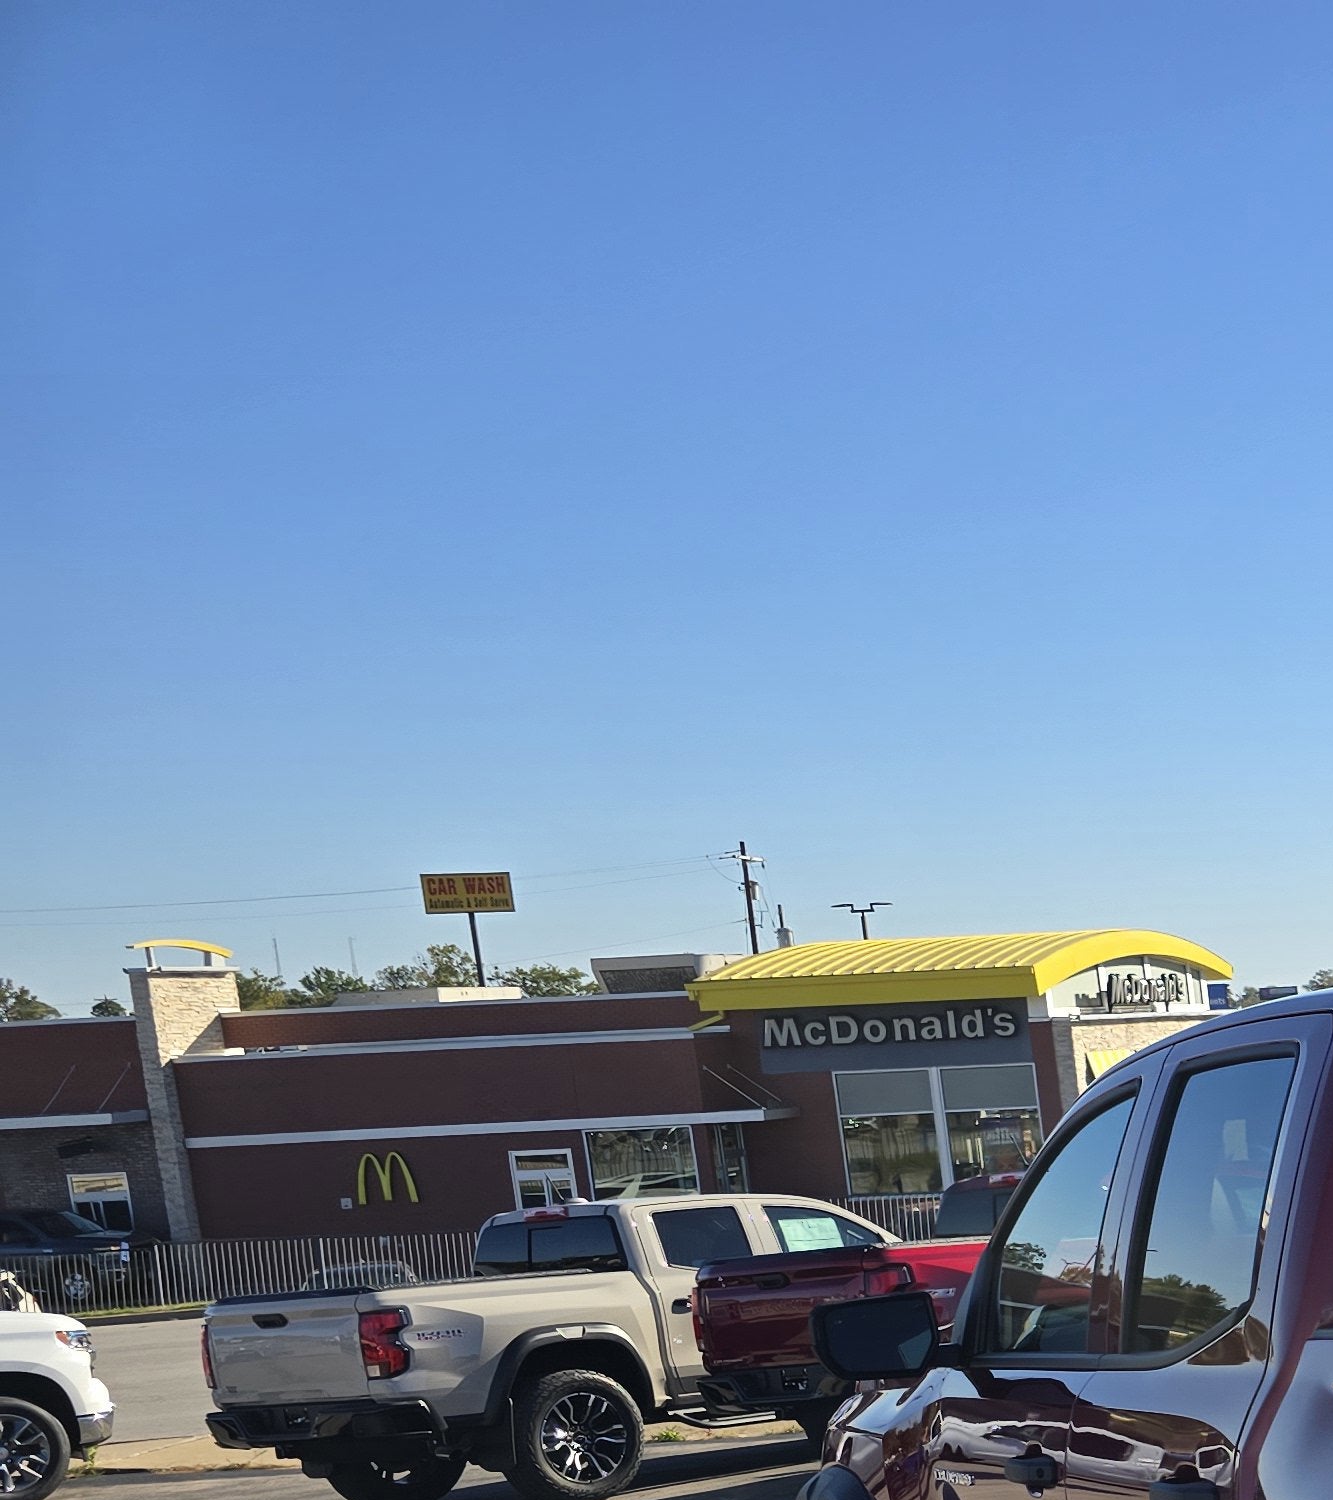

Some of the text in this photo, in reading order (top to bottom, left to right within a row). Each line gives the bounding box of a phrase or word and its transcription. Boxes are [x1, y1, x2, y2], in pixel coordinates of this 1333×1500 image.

[426, 876, 507, 896] CAR WASH
[763, 1008, 1016, 1047] McDonald's
